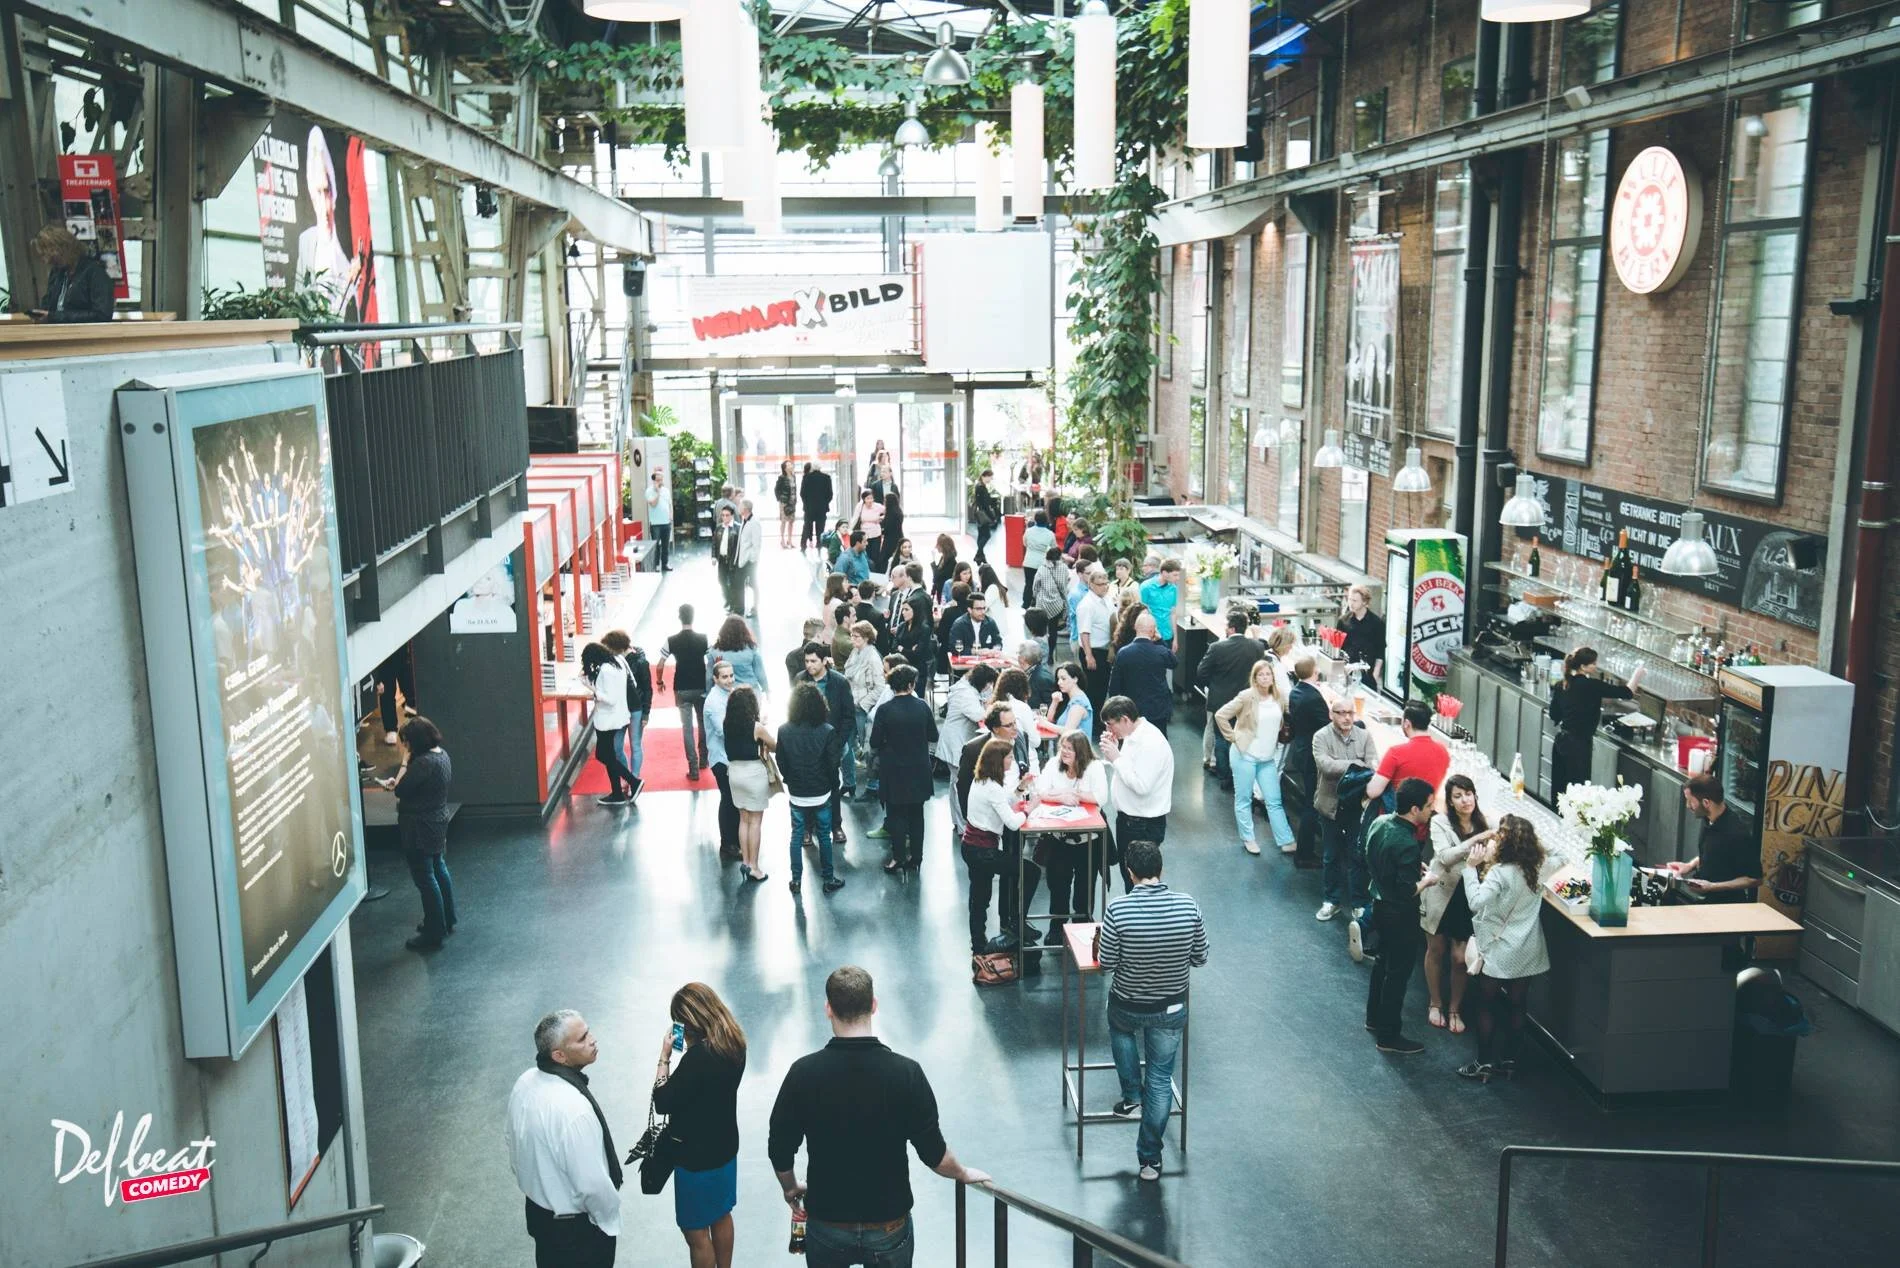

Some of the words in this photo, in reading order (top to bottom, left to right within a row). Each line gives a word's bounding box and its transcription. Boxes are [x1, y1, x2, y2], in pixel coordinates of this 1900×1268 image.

[65, 179, 112, 187] THEATERHAUS
[828, 282, 904, 313] BILD
[1658, 510, 1682, 529] BITTE
[1648, 532, 1658, 547] IN
[1658, 535, 1673, 550] DIE
[1702, 522, 1743, 556] AUX
